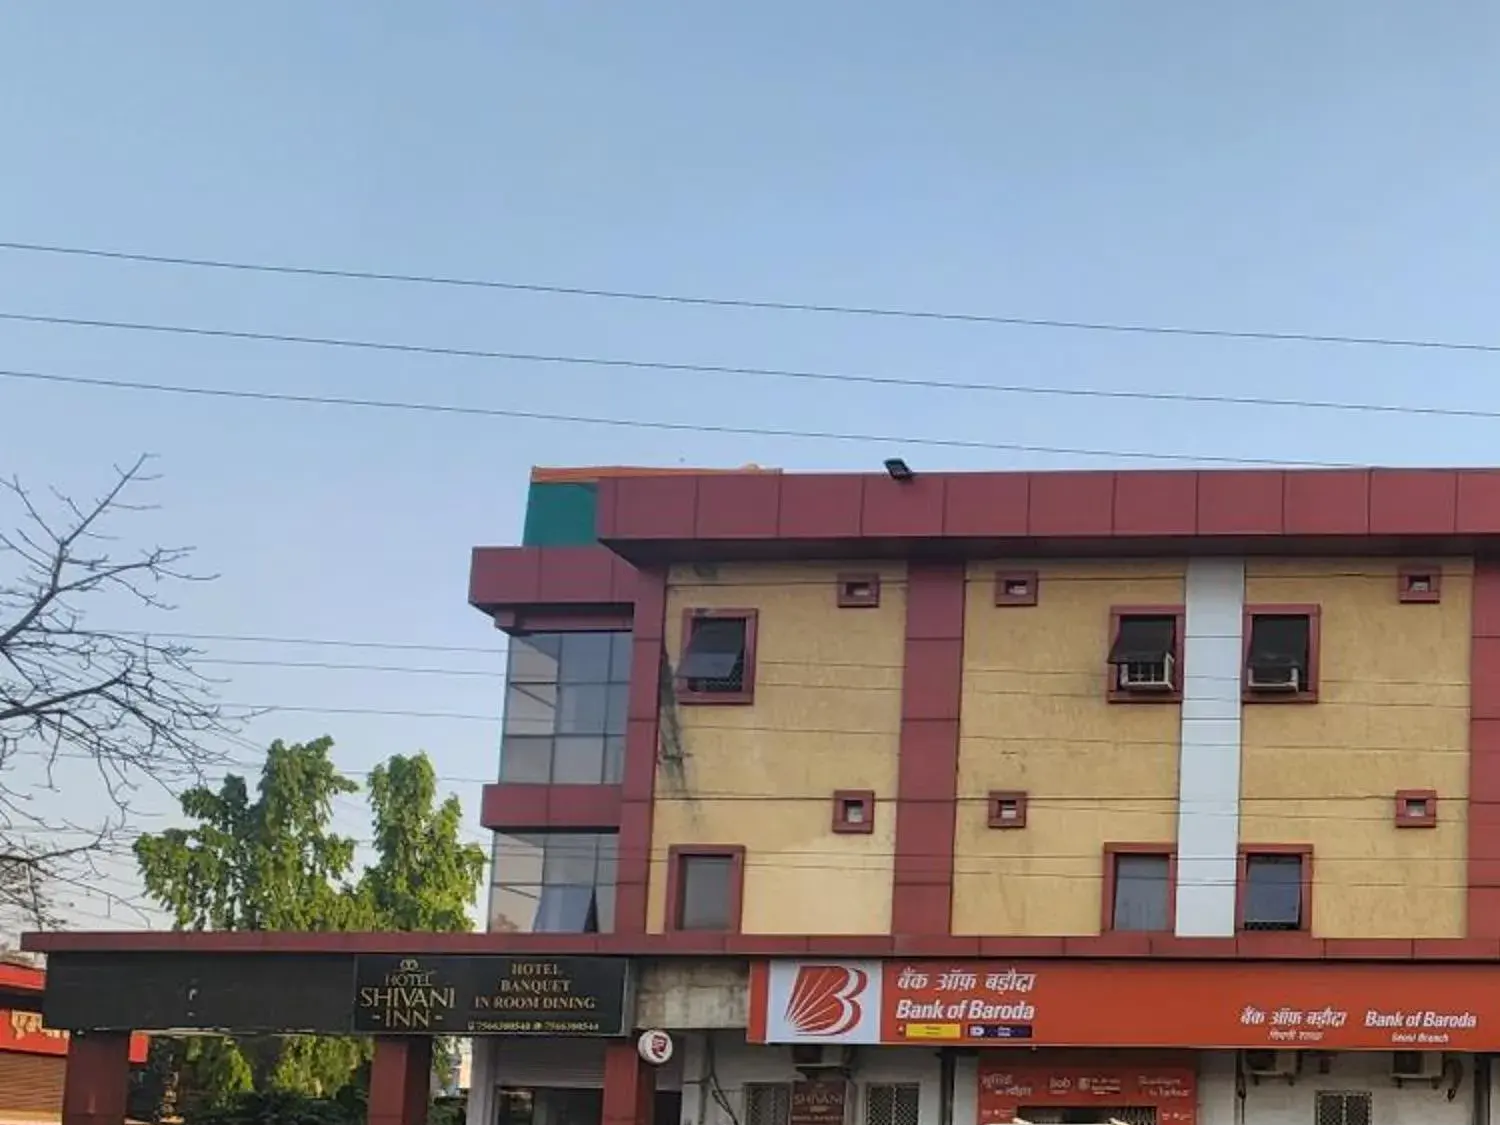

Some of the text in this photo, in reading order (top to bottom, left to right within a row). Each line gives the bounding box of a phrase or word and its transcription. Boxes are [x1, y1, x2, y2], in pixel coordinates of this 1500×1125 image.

[385, 970, 435, 986] HOTEL
[512, 963, 560, 976] HOTEL
[501, 979, 571, 993] BANQUET
[897, 966, 929, 990] बैंक
[985, 967, 1037, 995] बड़ौदा
[360, 987, 455, 1008] SHIVANI
[475, 996, 596, 1009] IN ROOM DINING
[896, 999, 1036, 1020] Bank of Baroda
[1240, 1006, 1266, 1025] बैंक
[1306, 1007, 1347, 1029] बड़ौदा
[1365, 1010, 1477, 1028] Bank of Baroda
